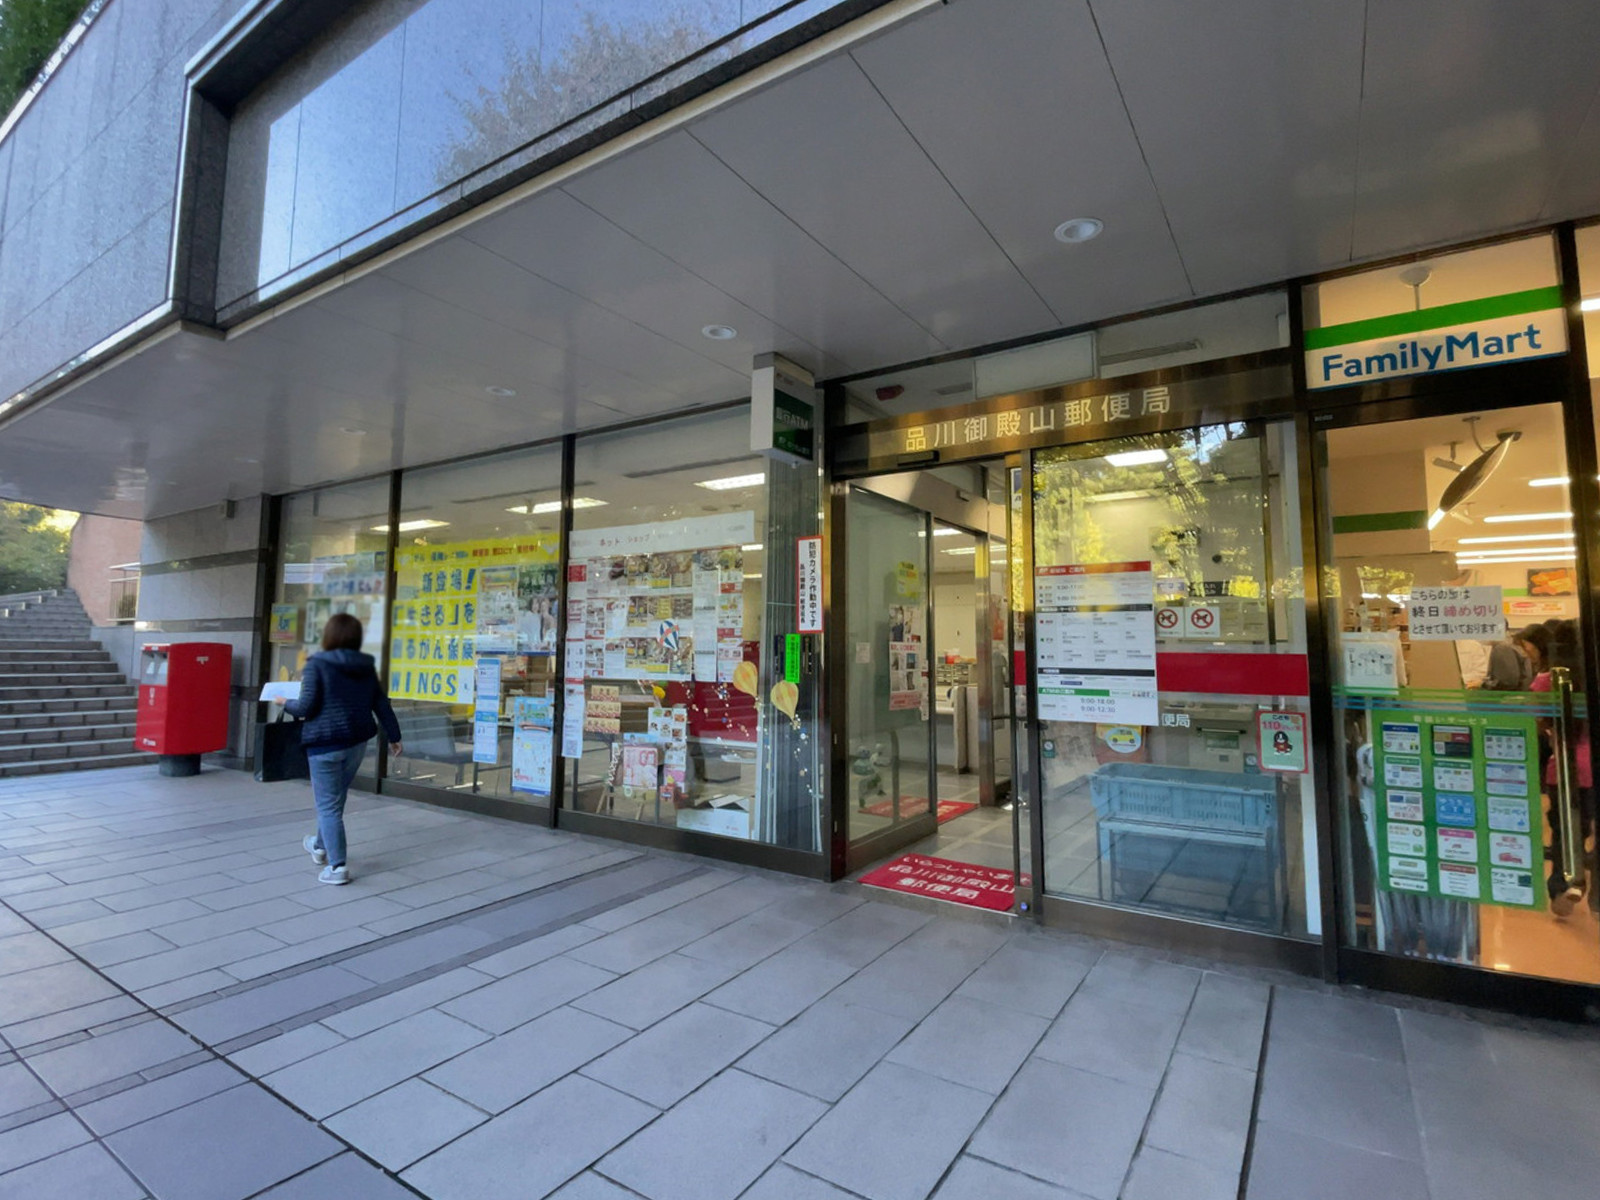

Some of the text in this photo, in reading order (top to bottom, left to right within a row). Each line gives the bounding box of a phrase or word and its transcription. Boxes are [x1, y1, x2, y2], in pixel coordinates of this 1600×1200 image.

[1322, 323, 1543, 382] FamilyMart
[904, 386, 1172, 452] 品川御殿山郵便局
[390, 671, 458, 696] WINGS
[896, 877, 981, 900] 郵便局
